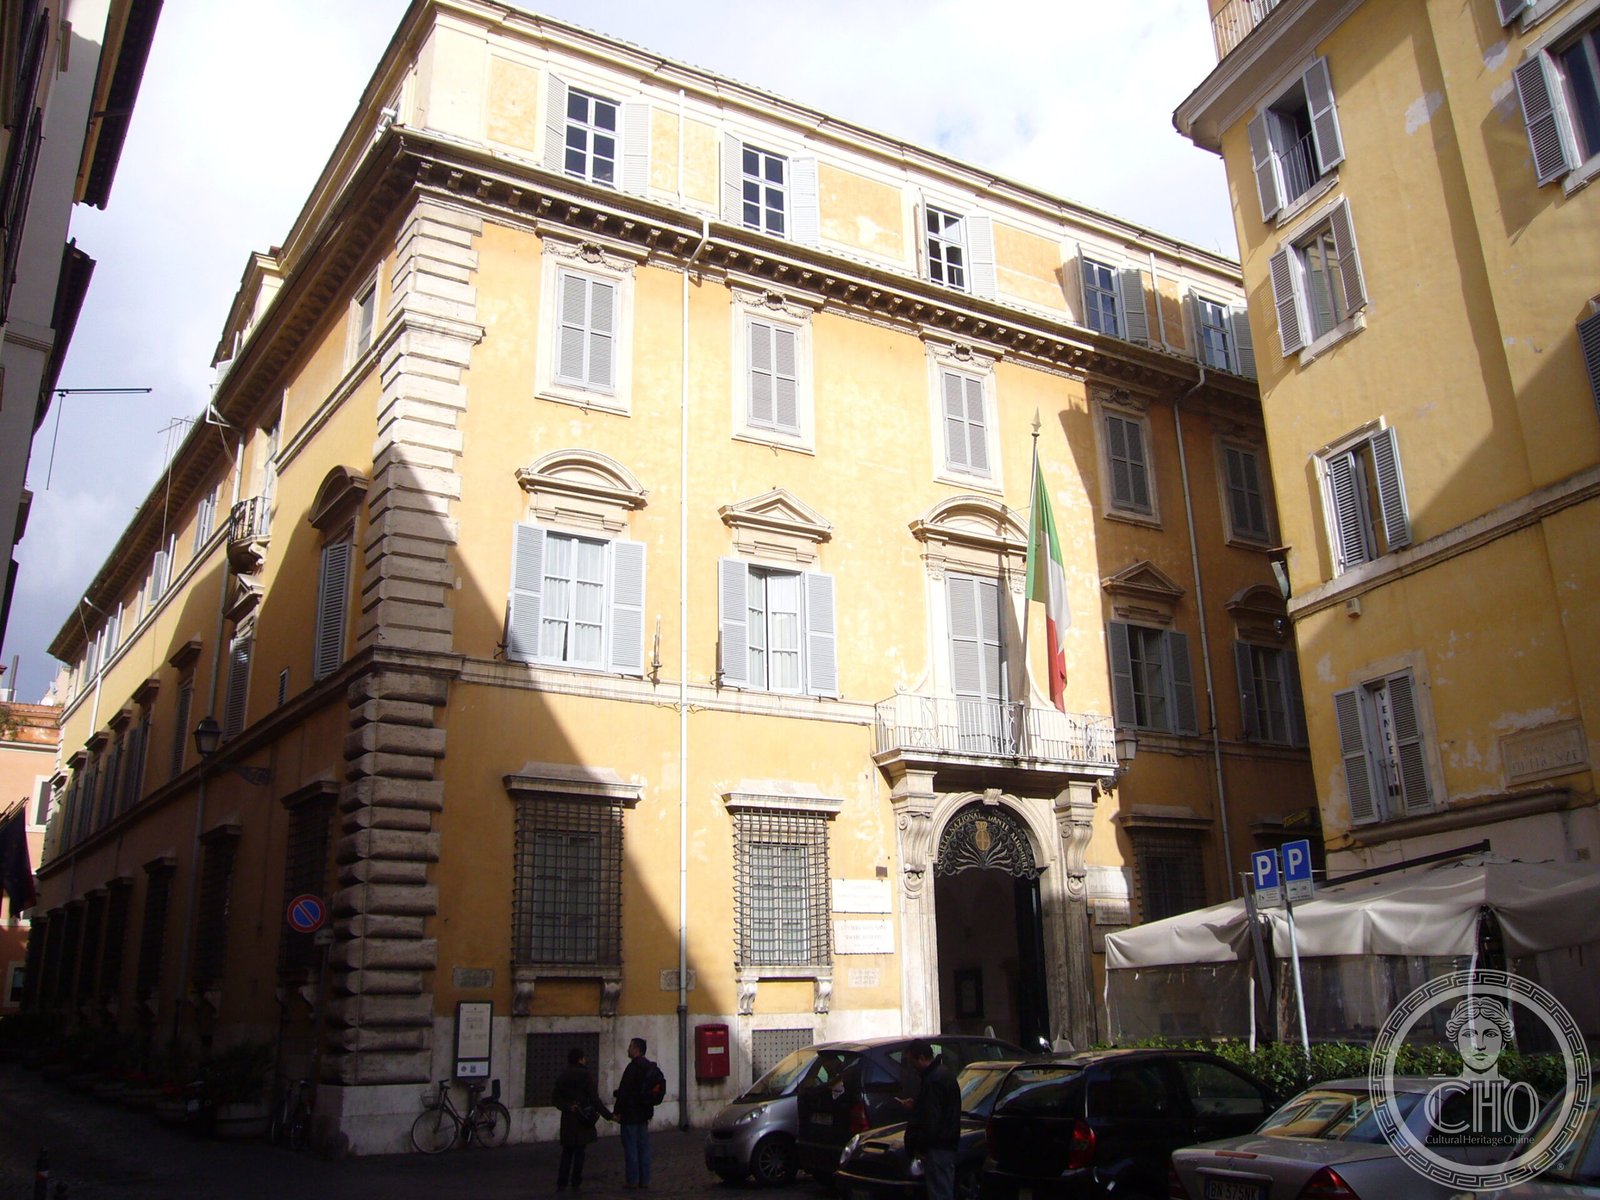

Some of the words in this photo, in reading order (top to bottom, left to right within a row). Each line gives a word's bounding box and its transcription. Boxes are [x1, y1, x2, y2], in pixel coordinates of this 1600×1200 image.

[988, 815, 1009, 832] DANTE
[1256, 855, 1271, 886] P
[1288, 848, 1303, 875] P
